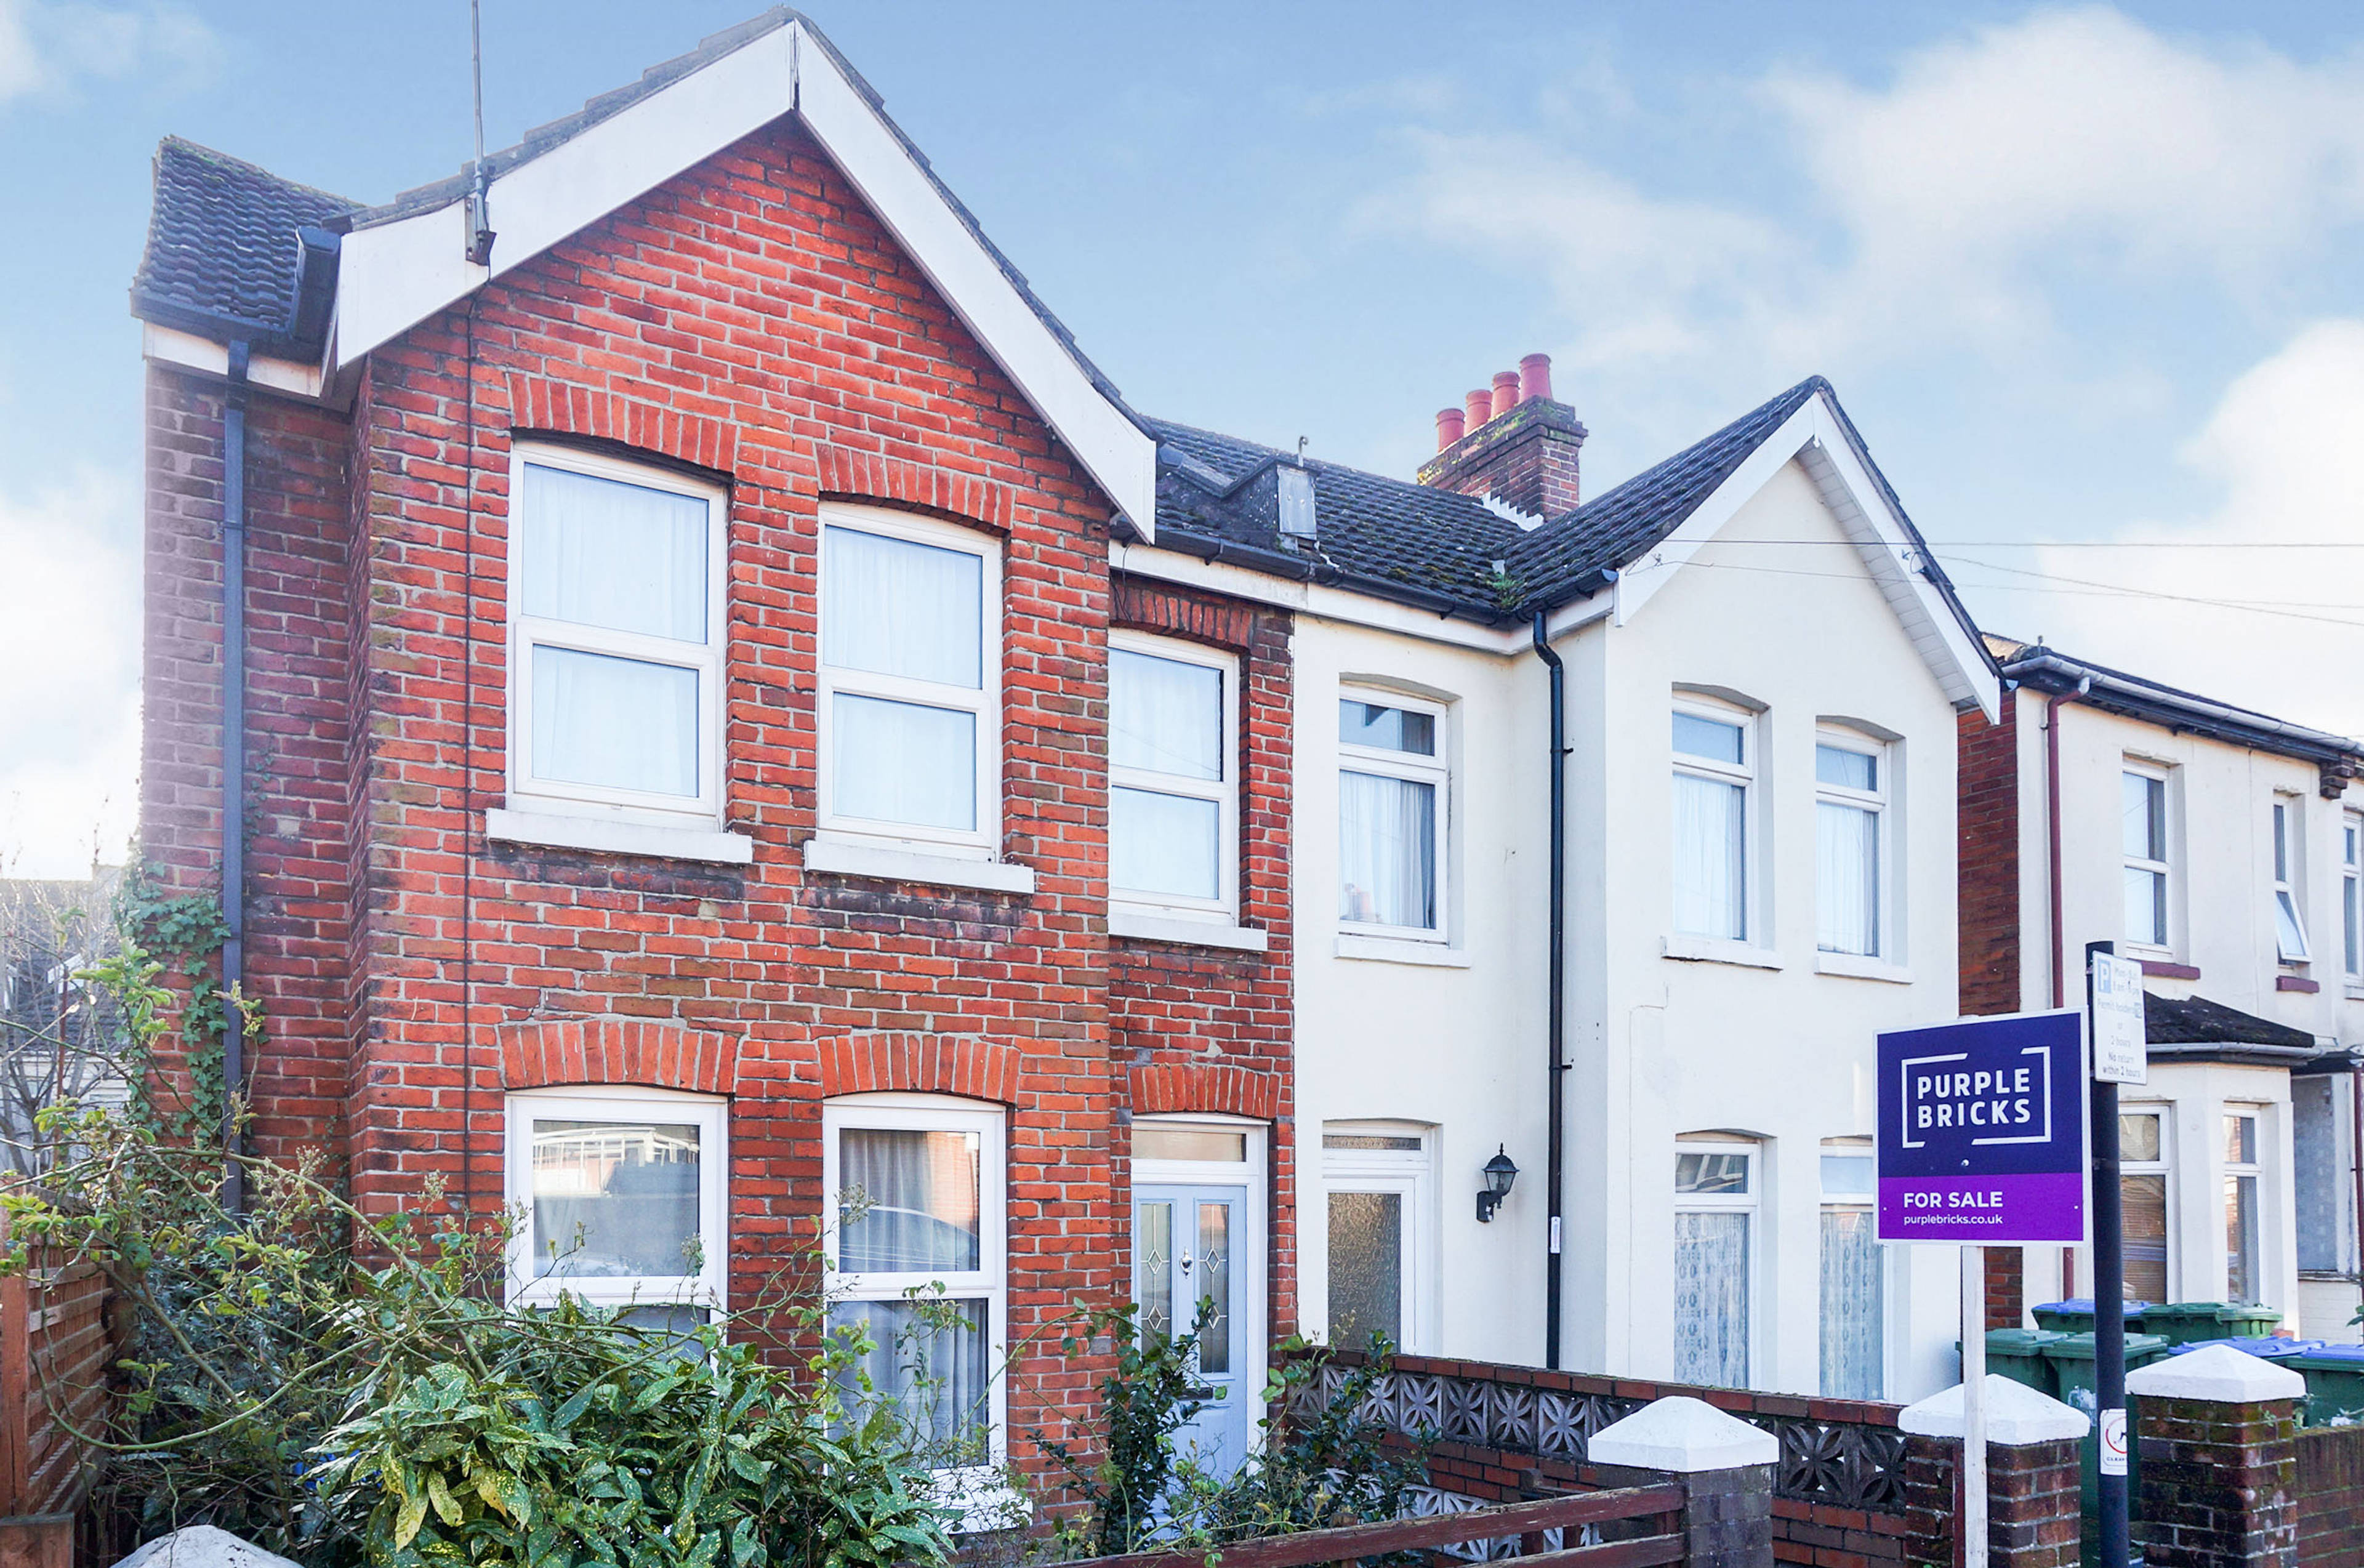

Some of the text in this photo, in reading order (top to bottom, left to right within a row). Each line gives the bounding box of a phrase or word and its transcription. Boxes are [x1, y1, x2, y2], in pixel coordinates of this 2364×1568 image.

[2100, 963, 2110, 991] P
[1917, 1067, 2030, 1100] PURPLE
[1917, 1098, 2031, 1129] BRICKS
[1903, 1191, 2004, 1208] FOR SALE
[1903, 1213, 2004, 1226] purplebricks.co.uk
